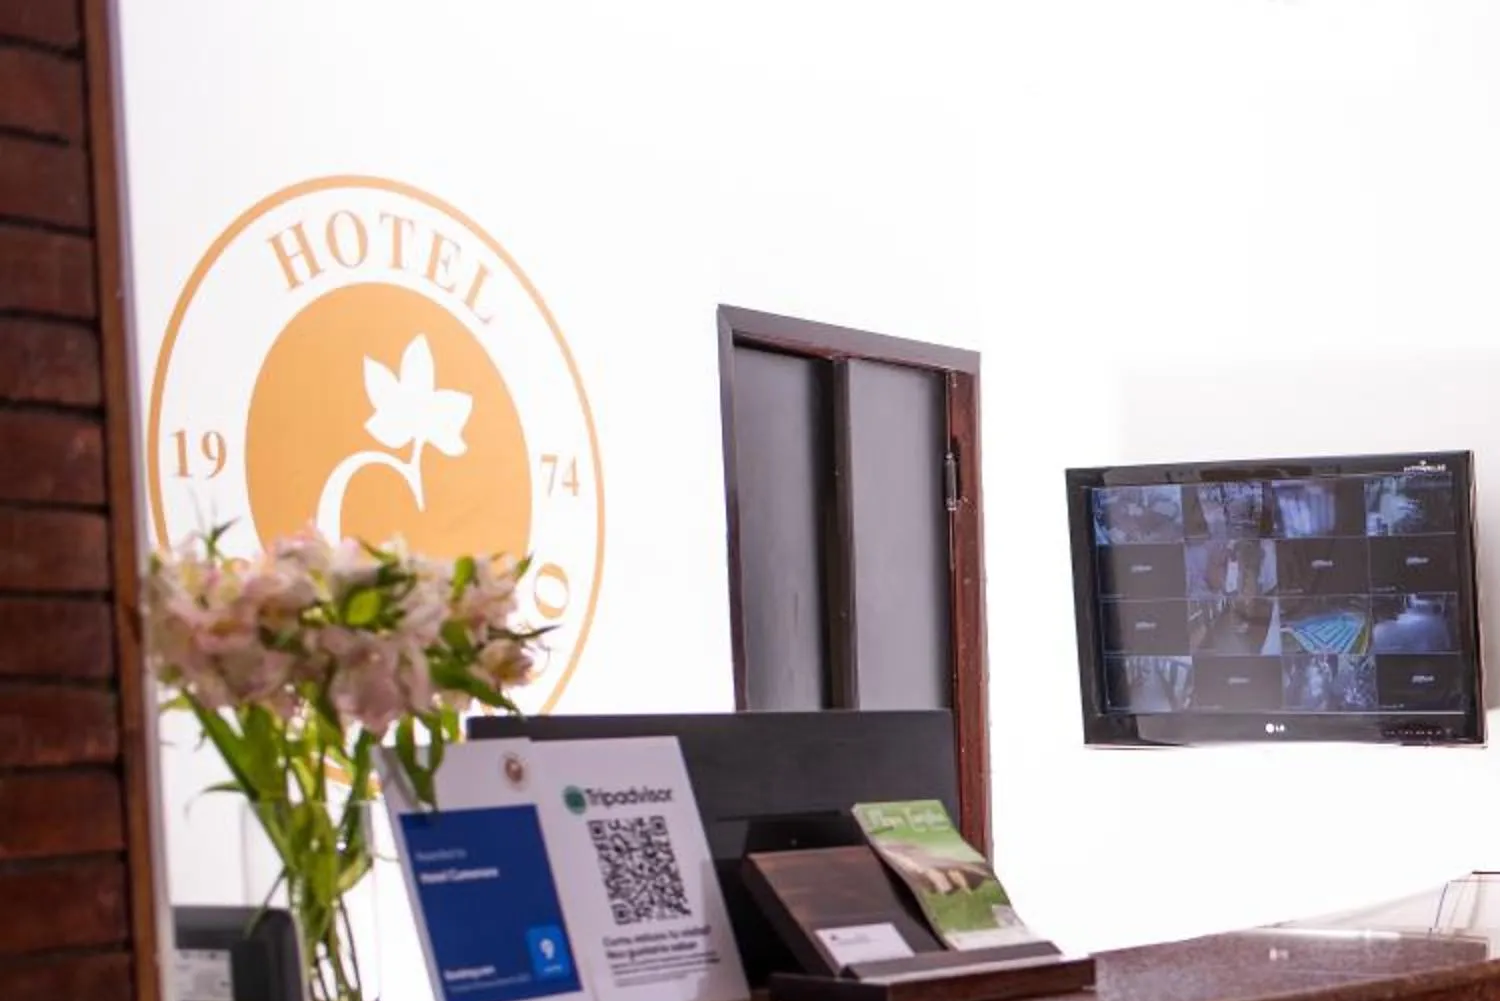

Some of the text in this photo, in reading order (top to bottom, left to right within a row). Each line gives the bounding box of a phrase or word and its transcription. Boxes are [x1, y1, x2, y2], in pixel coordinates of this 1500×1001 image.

[266, 209, 495, 325] HOTEL
[170, 429, 581, 498] 19 74
[585, 786, 673, 810] Tripadvisor
